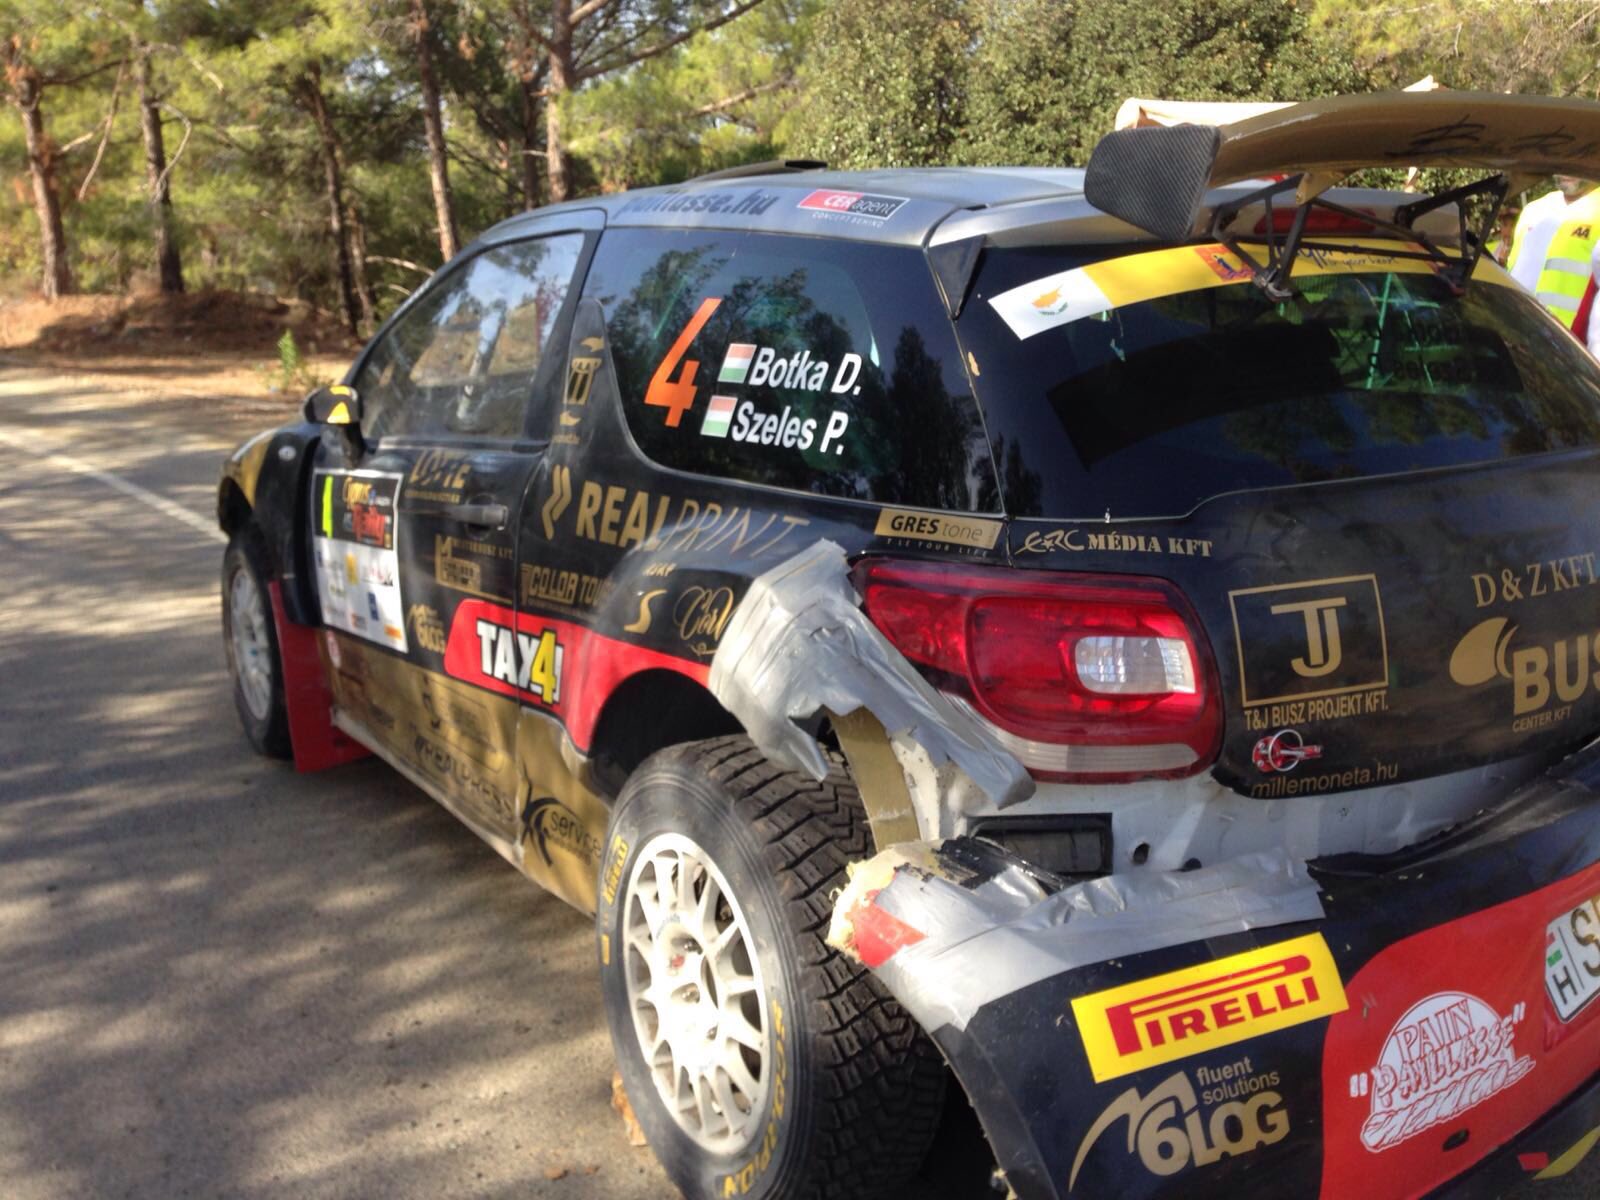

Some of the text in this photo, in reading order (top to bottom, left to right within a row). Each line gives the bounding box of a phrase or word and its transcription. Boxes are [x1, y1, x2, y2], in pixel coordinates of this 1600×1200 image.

[644, 298, 722, 427] 4
[749, 347, 863, 396] Botka D.
[732, 401, 849, 456] Szeles P.
[890, 514, 940, 535] GRES
[942, 523, 983, 542] tone
[1087, 530, 1213, 557] MÉDIA KFT
[1471, 552, 1597, 608] D & Z KFT
[1513, 632, 1600, 715] BU
[1244, 689, 1389, 731] T&J BUSZ PROJEKT KFT.
[1512, 706, 1572, 733] CENTER KFT
[1251, 761, 1399, 798] millemoneta.hu
[1105, 954, 1321, 1057] PIRELLI
[1552, 965, 1578, 1005] H
[1393, 999, 1476, 1063] PAIN
[1197, 1055, 1253, 1087] fluent
[1202, 1070, 1281, 1106] solutions
